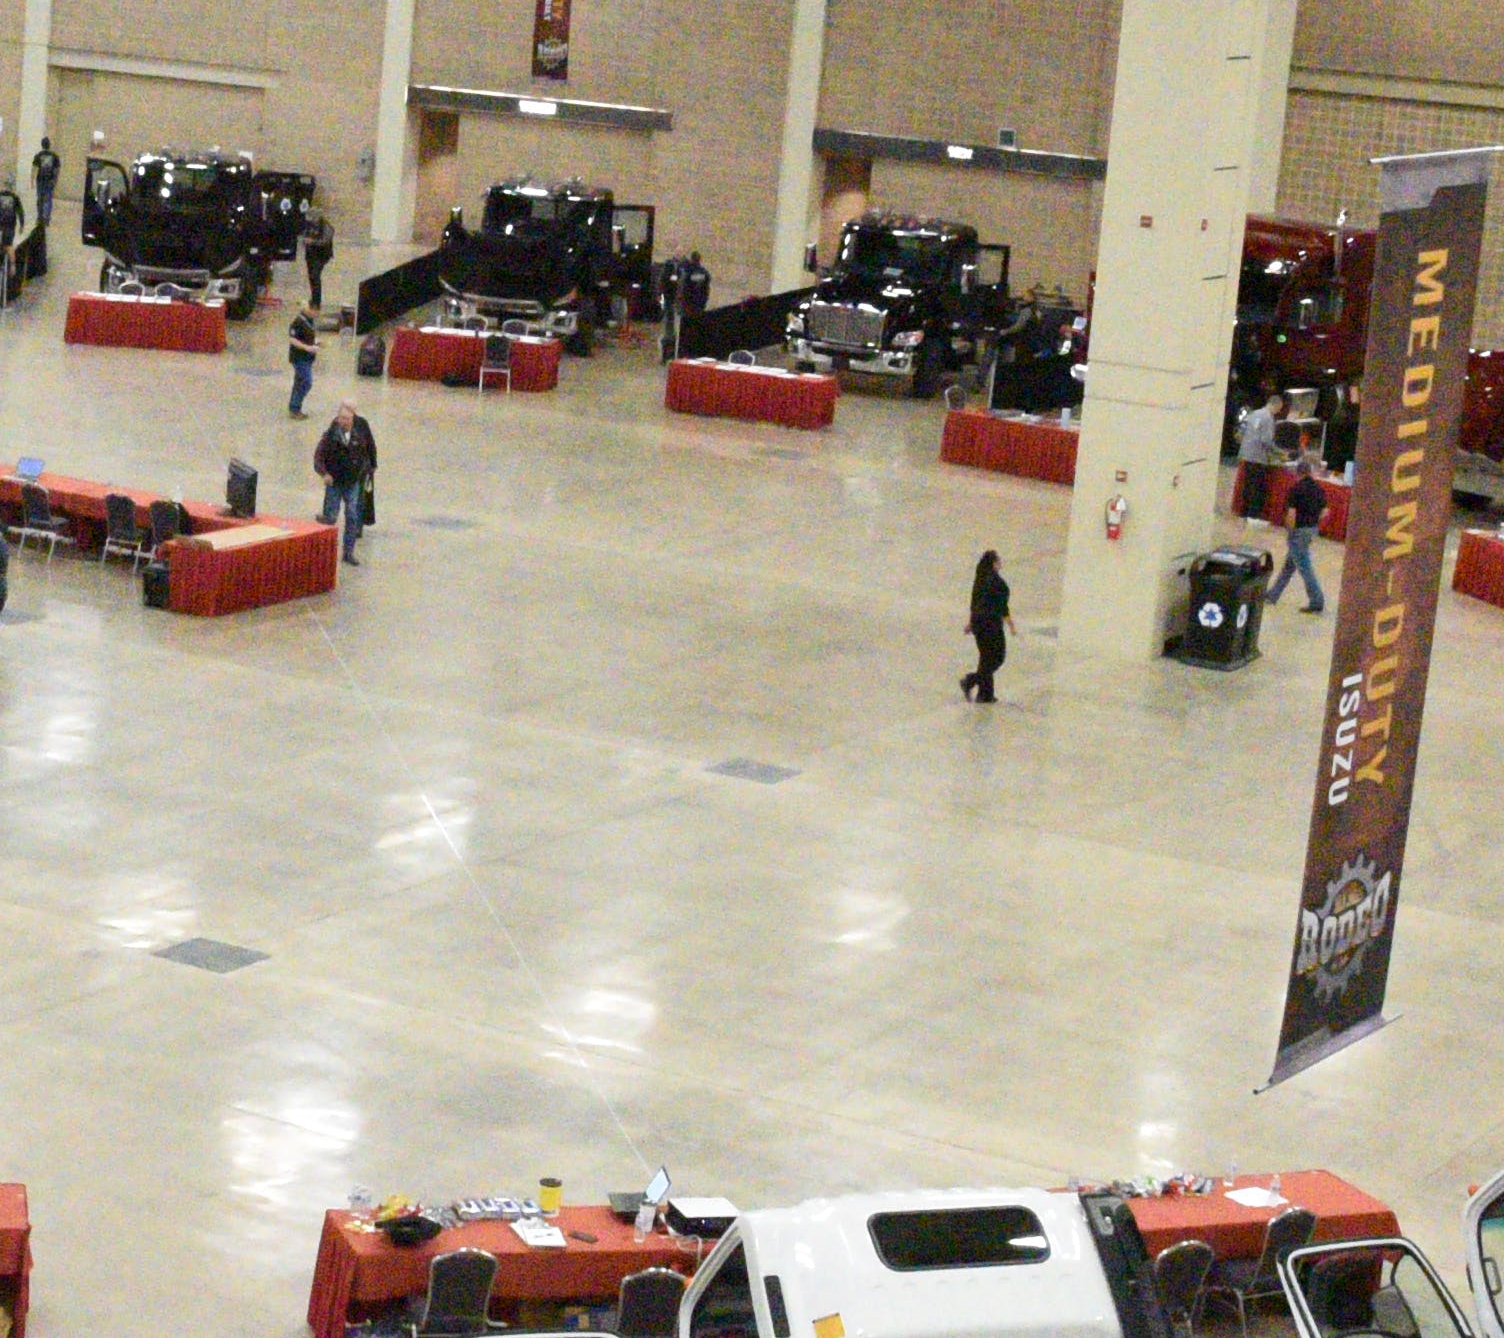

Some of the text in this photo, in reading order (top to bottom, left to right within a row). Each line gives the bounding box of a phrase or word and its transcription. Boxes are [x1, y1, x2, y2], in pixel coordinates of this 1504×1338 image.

[1355, 248, 1449, 785] MEDIUM-DUTY
[1328, 672, 1363, 807] ISUZU
[1296, 870, 1391, 975] RODEO
